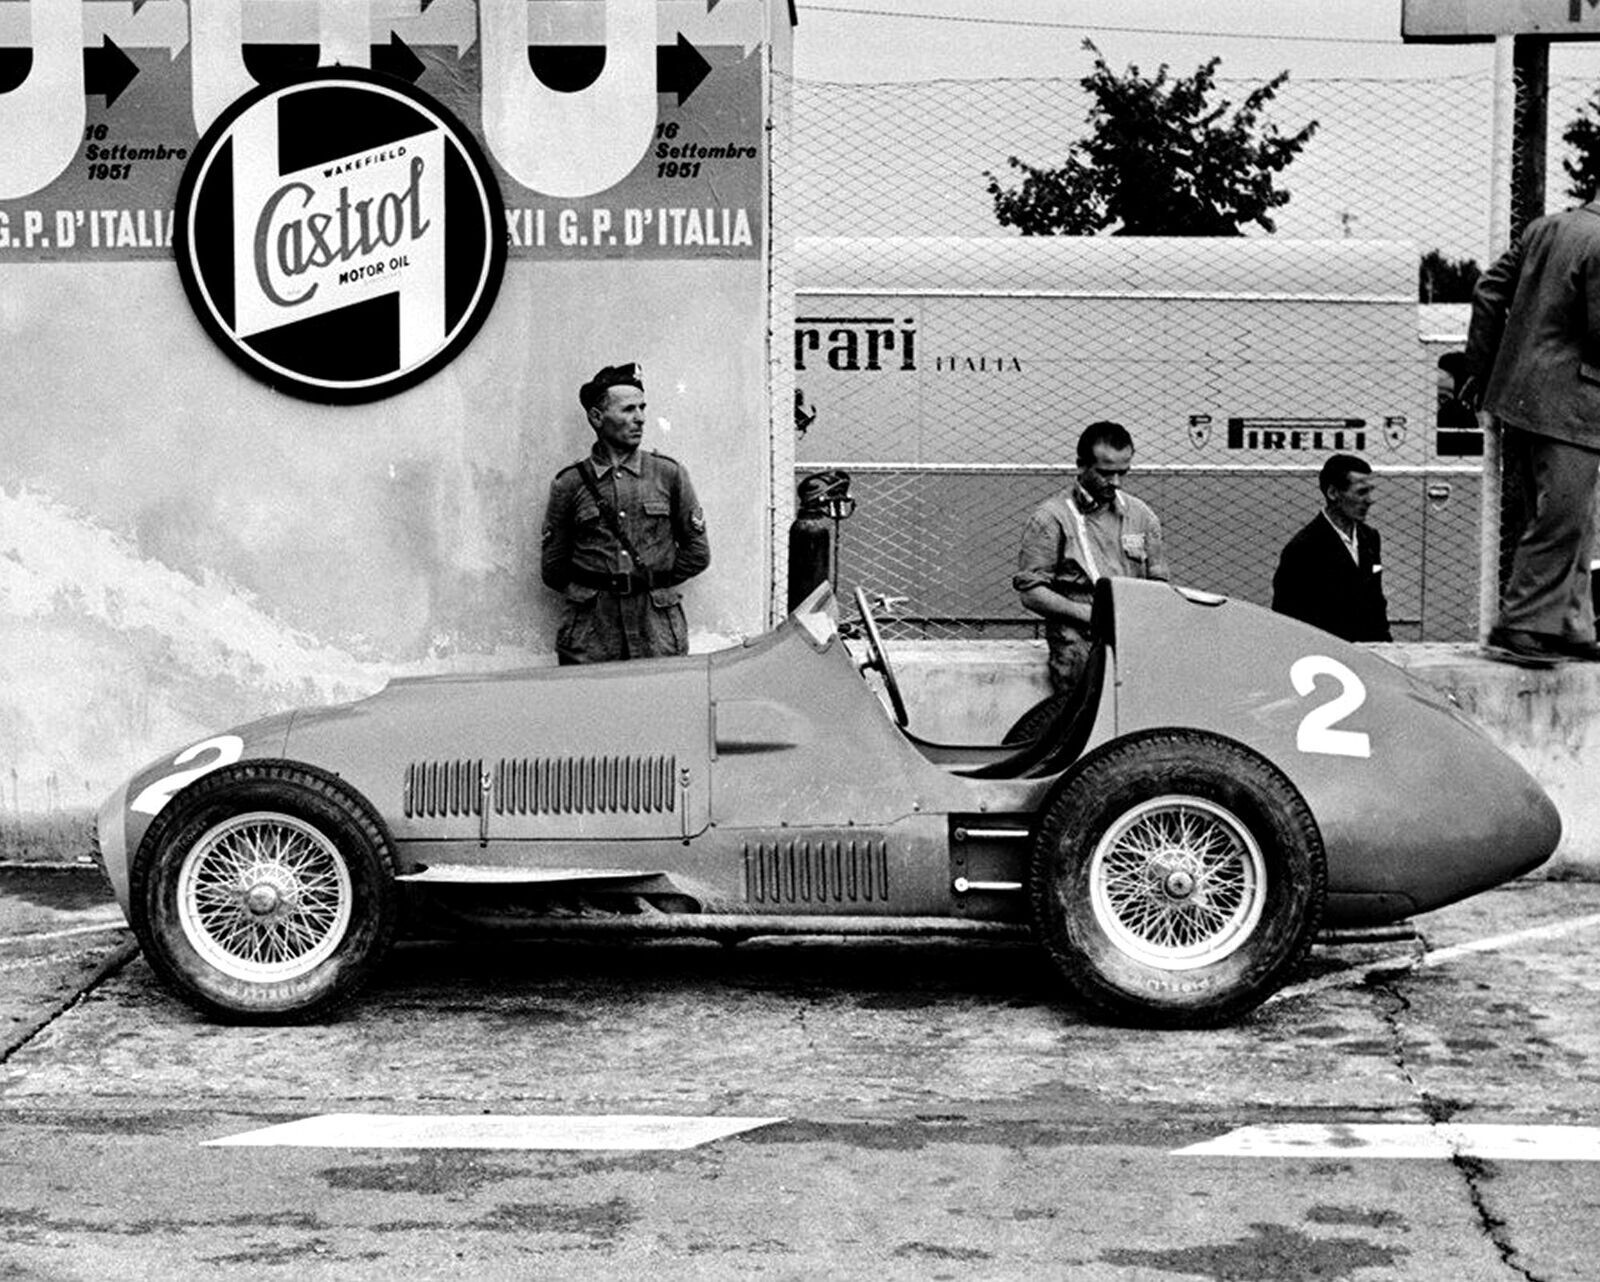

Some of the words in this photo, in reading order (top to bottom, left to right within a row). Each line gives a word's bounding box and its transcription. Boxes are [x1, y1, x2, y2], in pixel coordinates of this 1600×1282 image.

[85, 124, 109, 141] 16
[655, 122, 680, 140] 16
[85, 143, 188, 161] Settembre
[323, 146, 407, 178] WAKEFIELD
[655, 142, 757, 159] Settembre
[88, 163, 132, 180] 1951
[656, 161, 702, 178] 1951
[254, 156, 431, 307] Castrol
[559, 208, 617, 246] G.P.
[624, 208, 754, 246] D'ITALIA
[338, 261, 385, 285] MOTOR
[389, 255, 410, 270] OIL
[1228, 417, 1367, 450] PIRELLI
[1289, 654, 1371, 758] 2
[130, 735, 244, 816] 2
